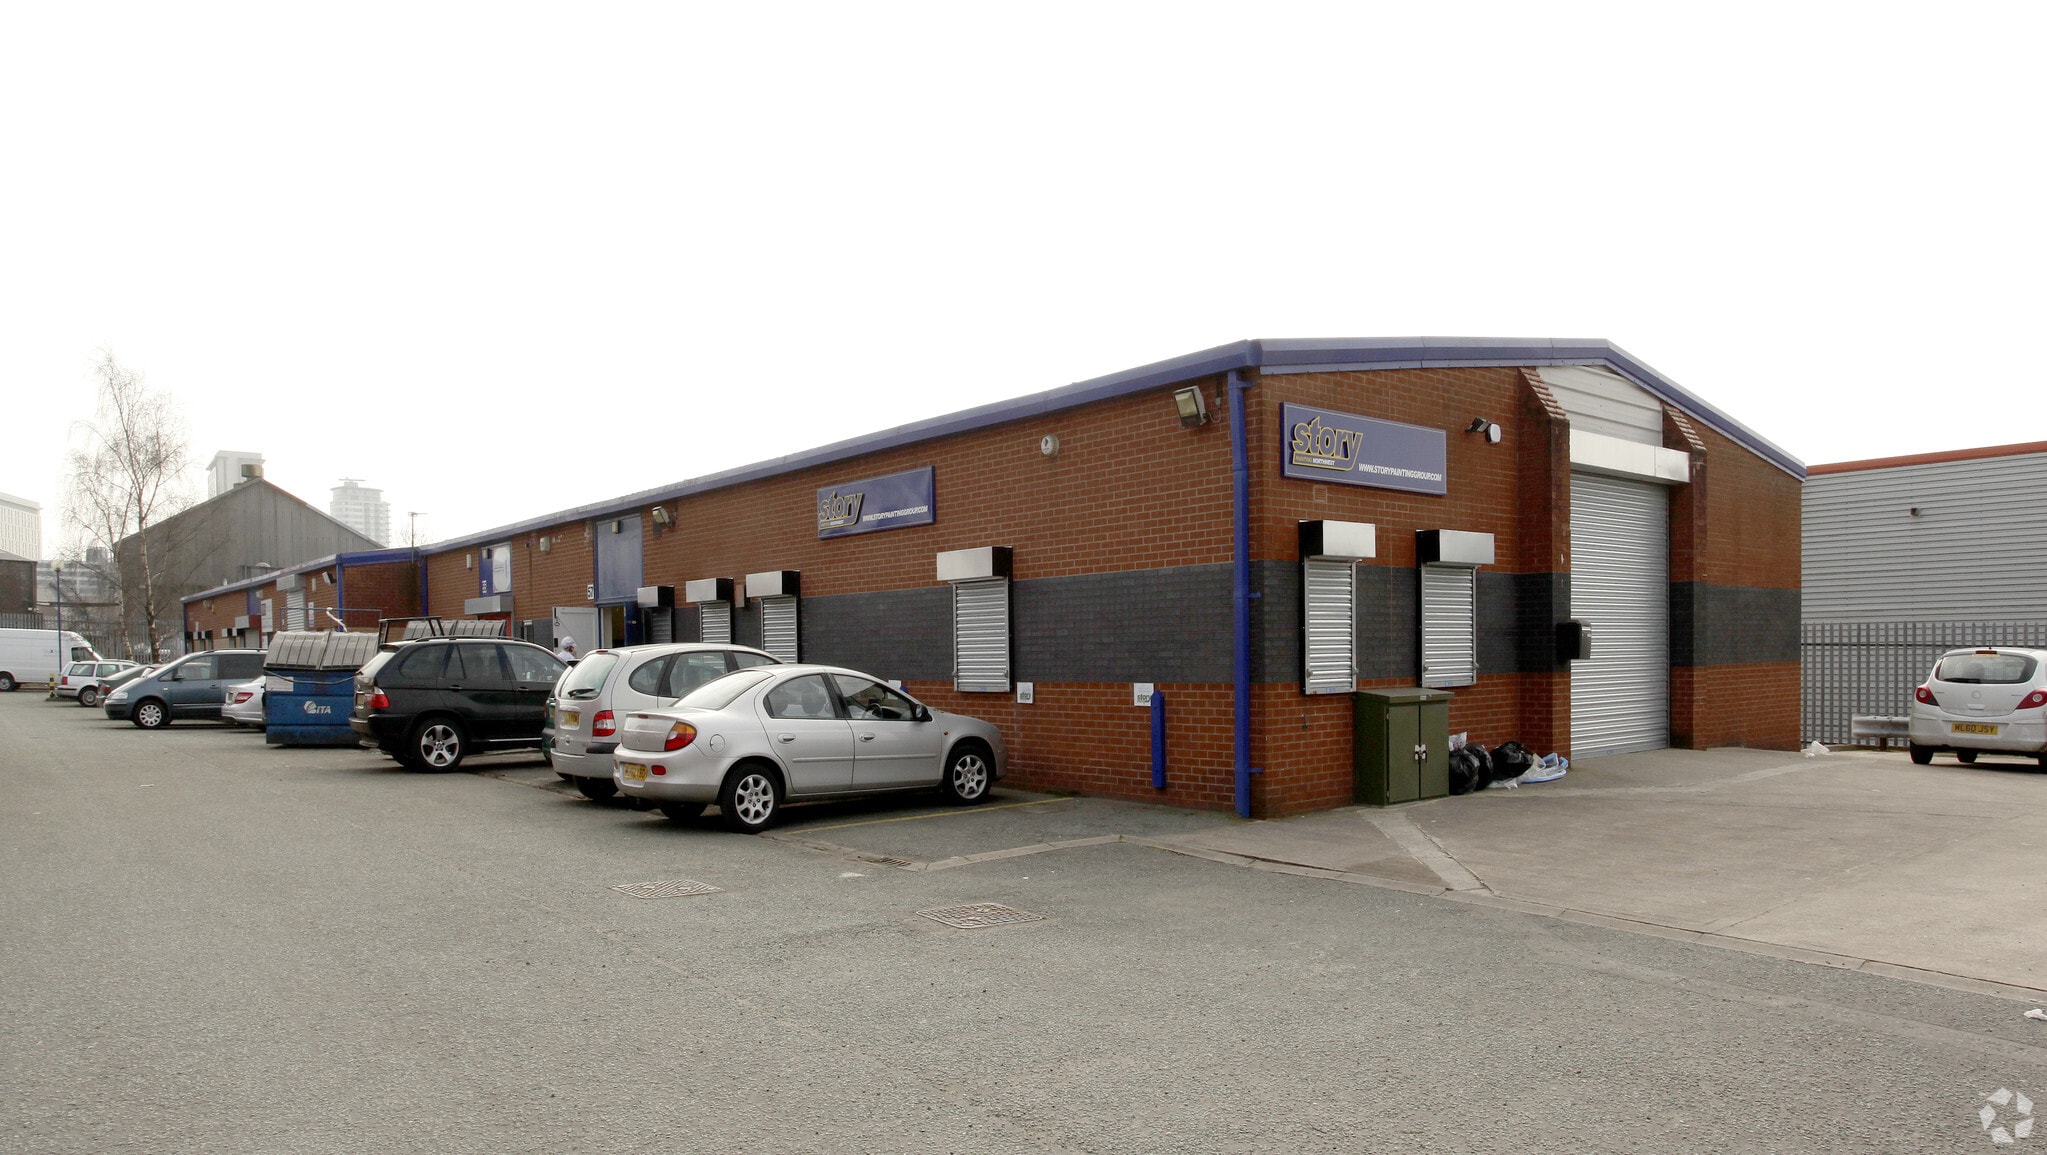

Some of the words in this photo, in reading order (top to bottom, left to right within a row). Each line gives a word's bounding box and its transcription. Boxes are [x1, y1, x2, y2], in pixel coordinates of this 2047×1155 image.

[1292, 416, 1363, 467] story
[820, 491, 864, 522] story
[1979, 725, 1995, 733] JSY
